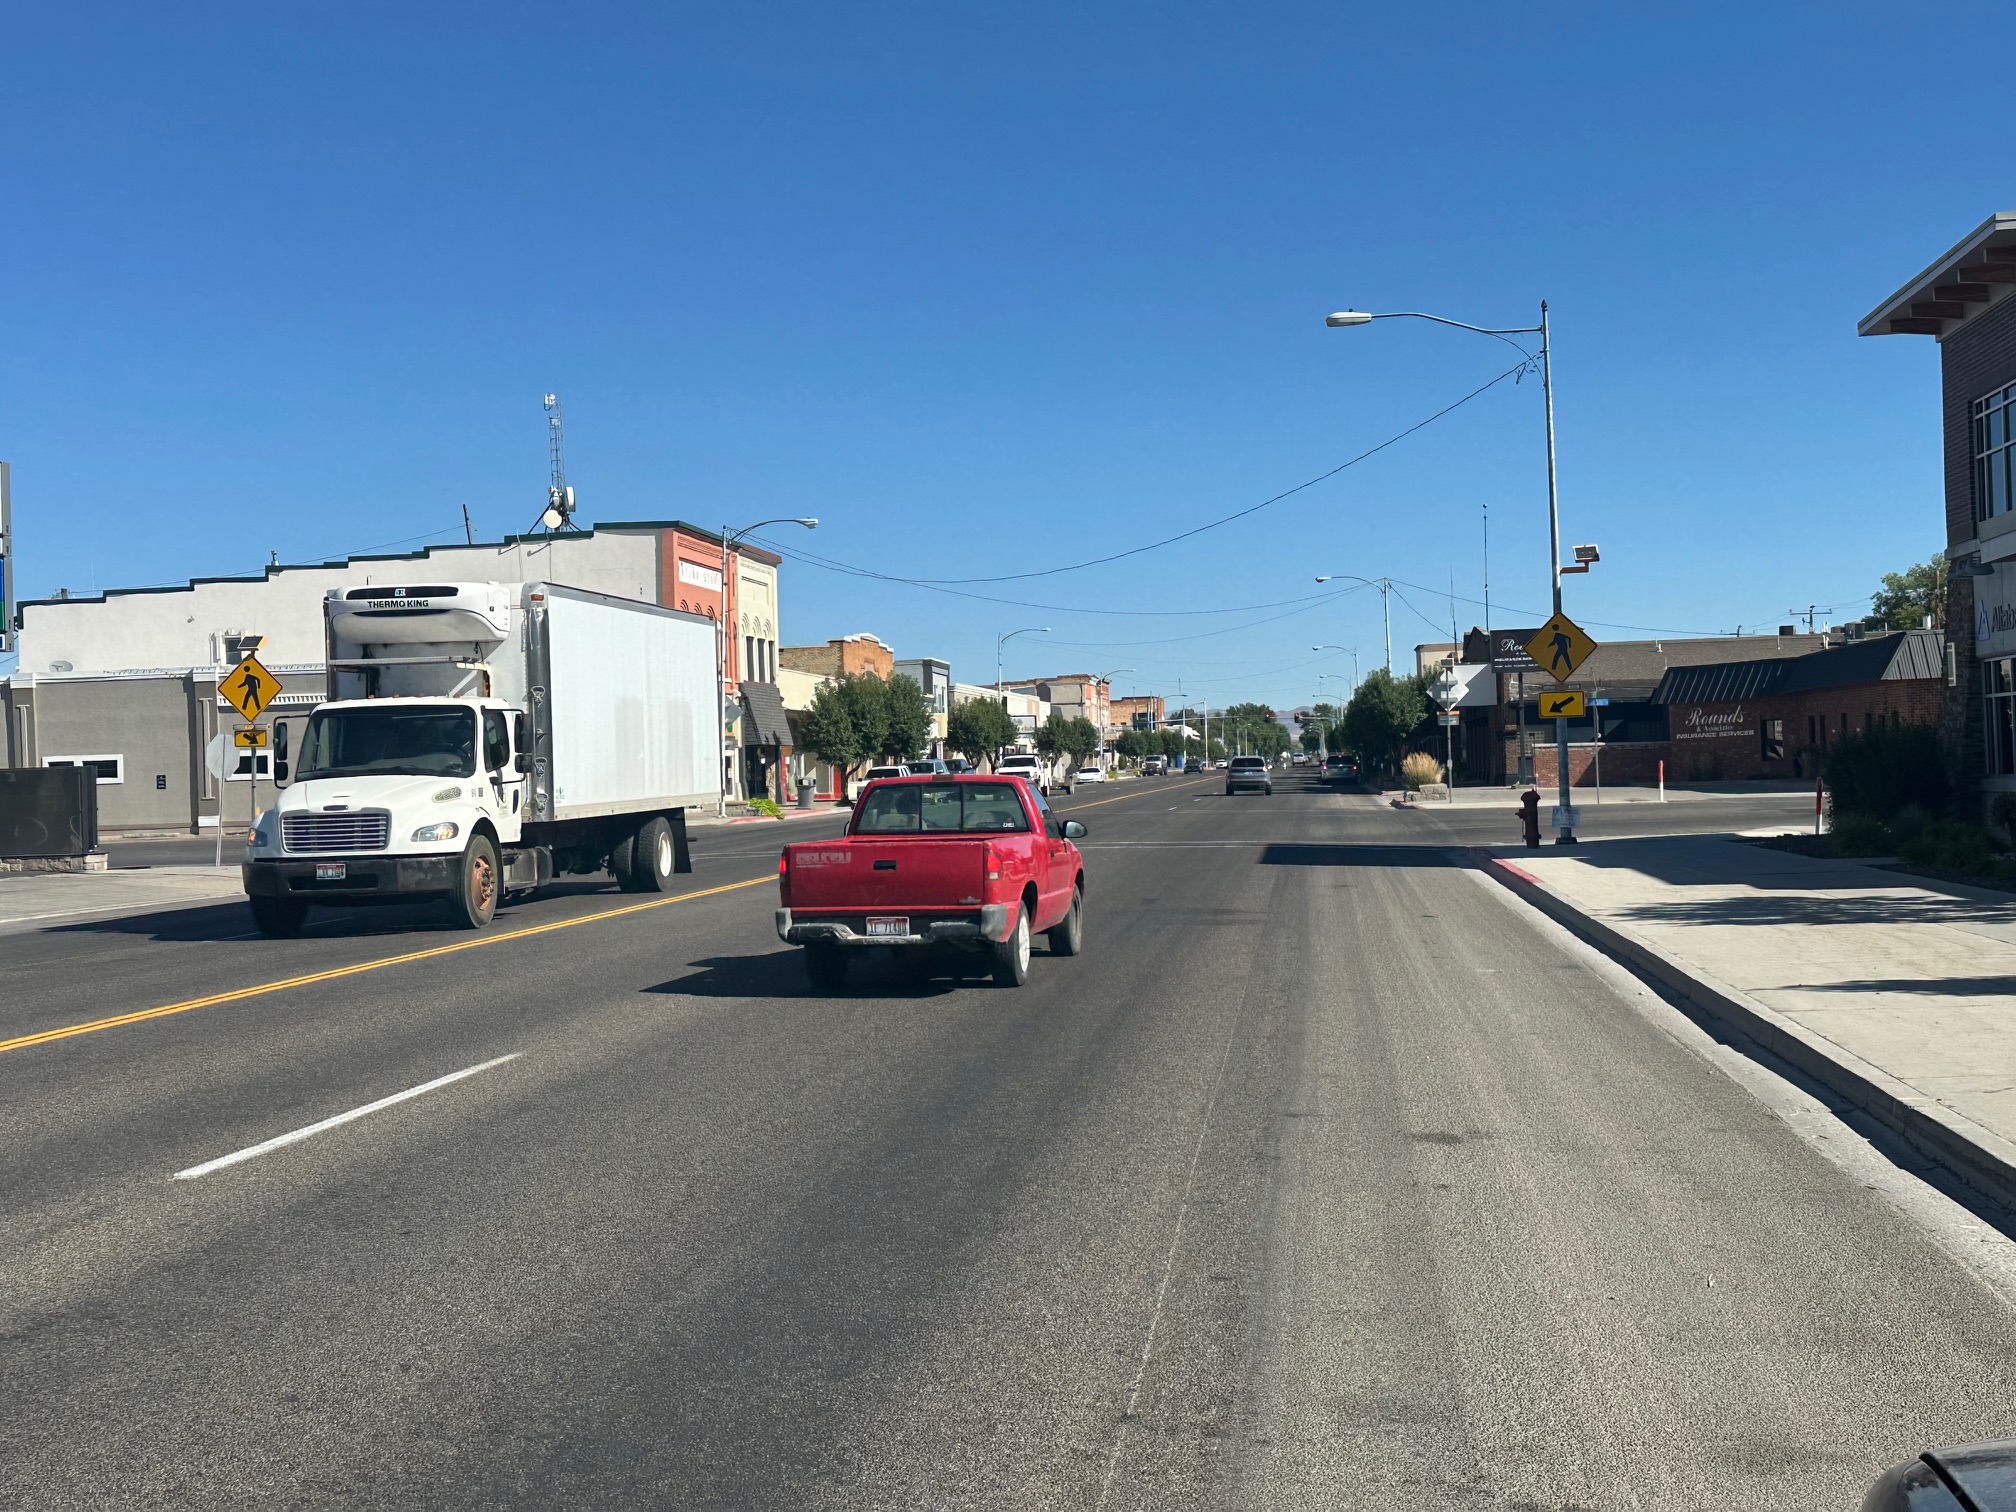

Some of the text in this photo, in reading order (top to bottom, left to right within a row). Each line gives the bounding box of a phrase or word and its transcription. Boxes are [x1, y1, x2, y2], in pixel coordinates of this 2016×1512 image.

[367, 599, 429, 609] THERMO KING
[1685, 705, 1744, 726] Rounds
[1718, 729, 1755, 737] SERVICES
